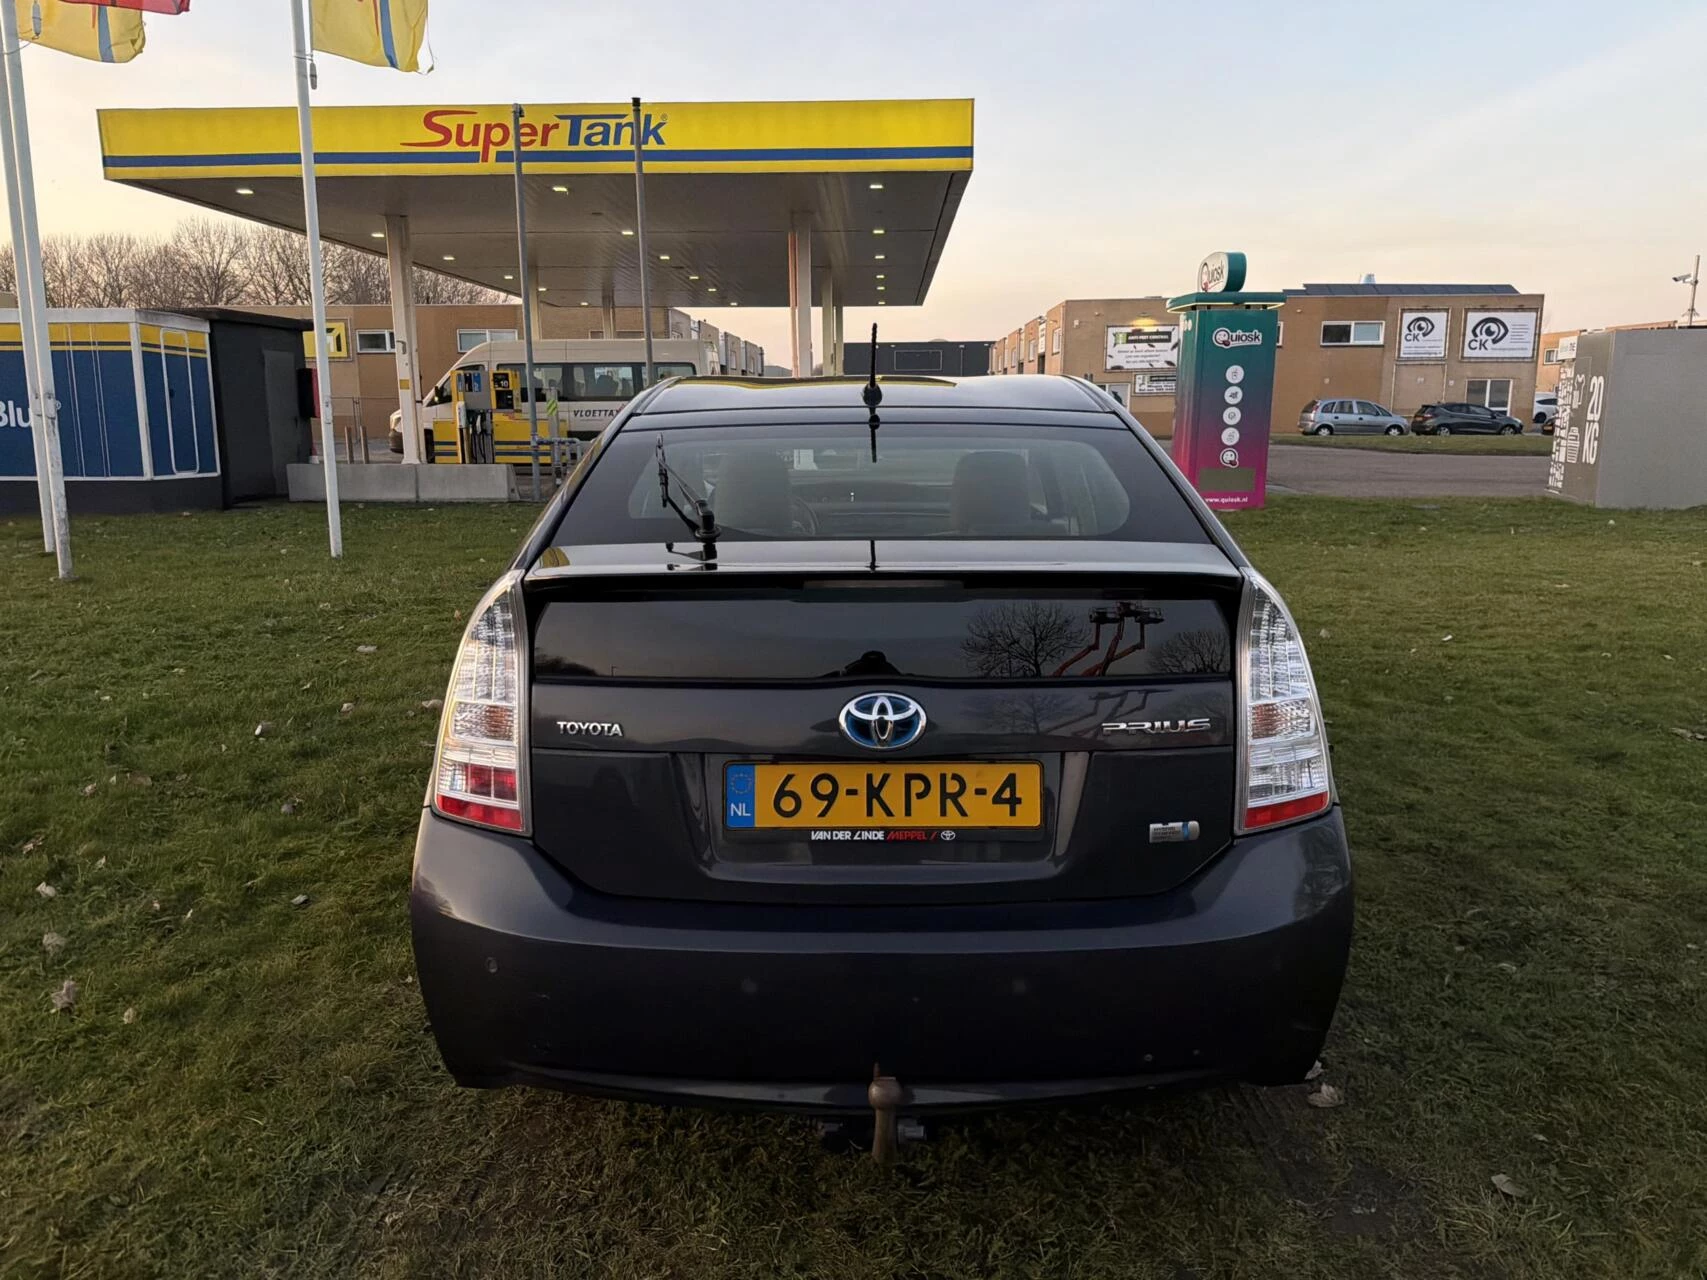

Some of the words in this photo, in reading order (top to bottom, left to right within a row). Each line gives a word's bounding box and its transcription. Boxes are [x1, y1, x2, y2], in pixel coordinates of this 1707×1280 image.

[1214, 328, 1261, 347] Quiosk
[1404, 333, 1420, 342] CK
[1468, 339, 1488, 350] CK
[1587, 375, 1604, 421] 20
[0, 400, 36, 427] Blu
[1582, 422, 1599, 465] KG
[556, 722, 622, 736] TOYOTA
[1101, 718, 1211, 735] PRIUS
[773, 773, 1022, 818] 69-KPR-4
[730, 803, 751, 817] NL
[811, 831, 831, 840] VAN
[832, 831, 851, 840] DER
[853, 831, 884, 840] LINDE
[886, 831, 927, 840] MEPPEL
